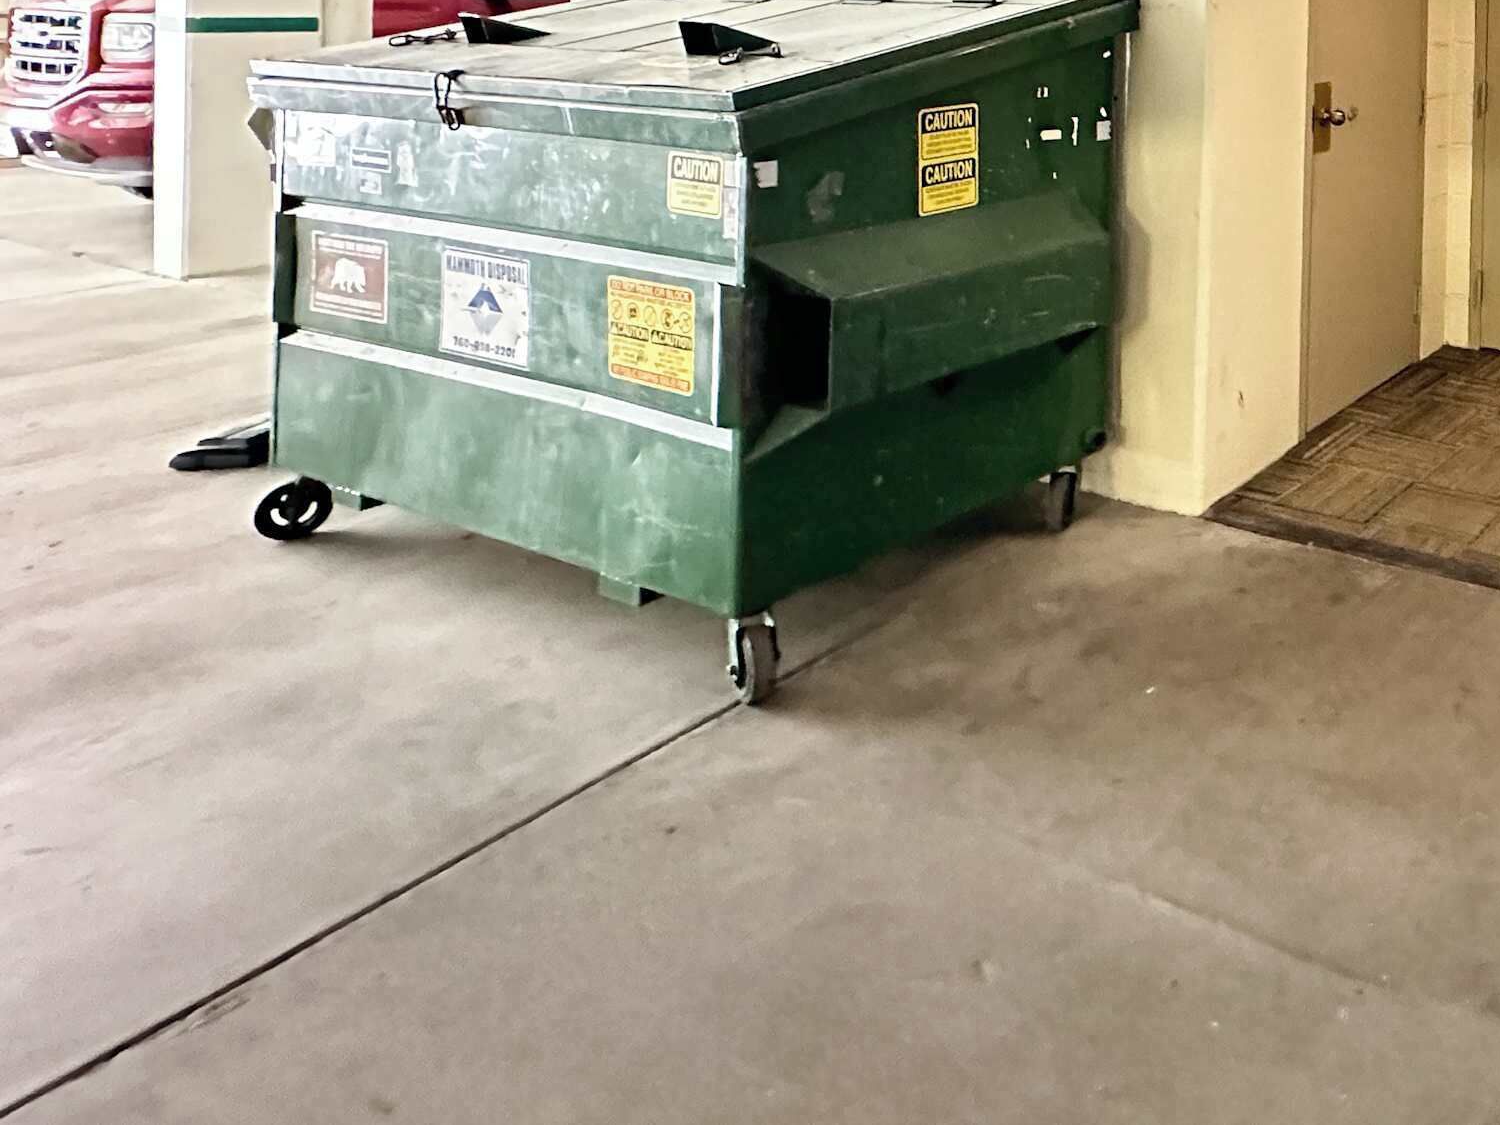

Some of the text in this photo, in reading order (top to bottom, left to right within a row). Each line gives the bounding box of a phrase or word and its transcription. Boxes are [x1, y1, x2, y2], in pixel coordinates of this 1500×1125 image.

[925, 109, 973, 132] CAUTION
[673, 156, 719, 183] CAUTION
[925, 159, 973, 185] CAUTION
[446, 255, 526, 285] MAMMOTH DISPOSAL
